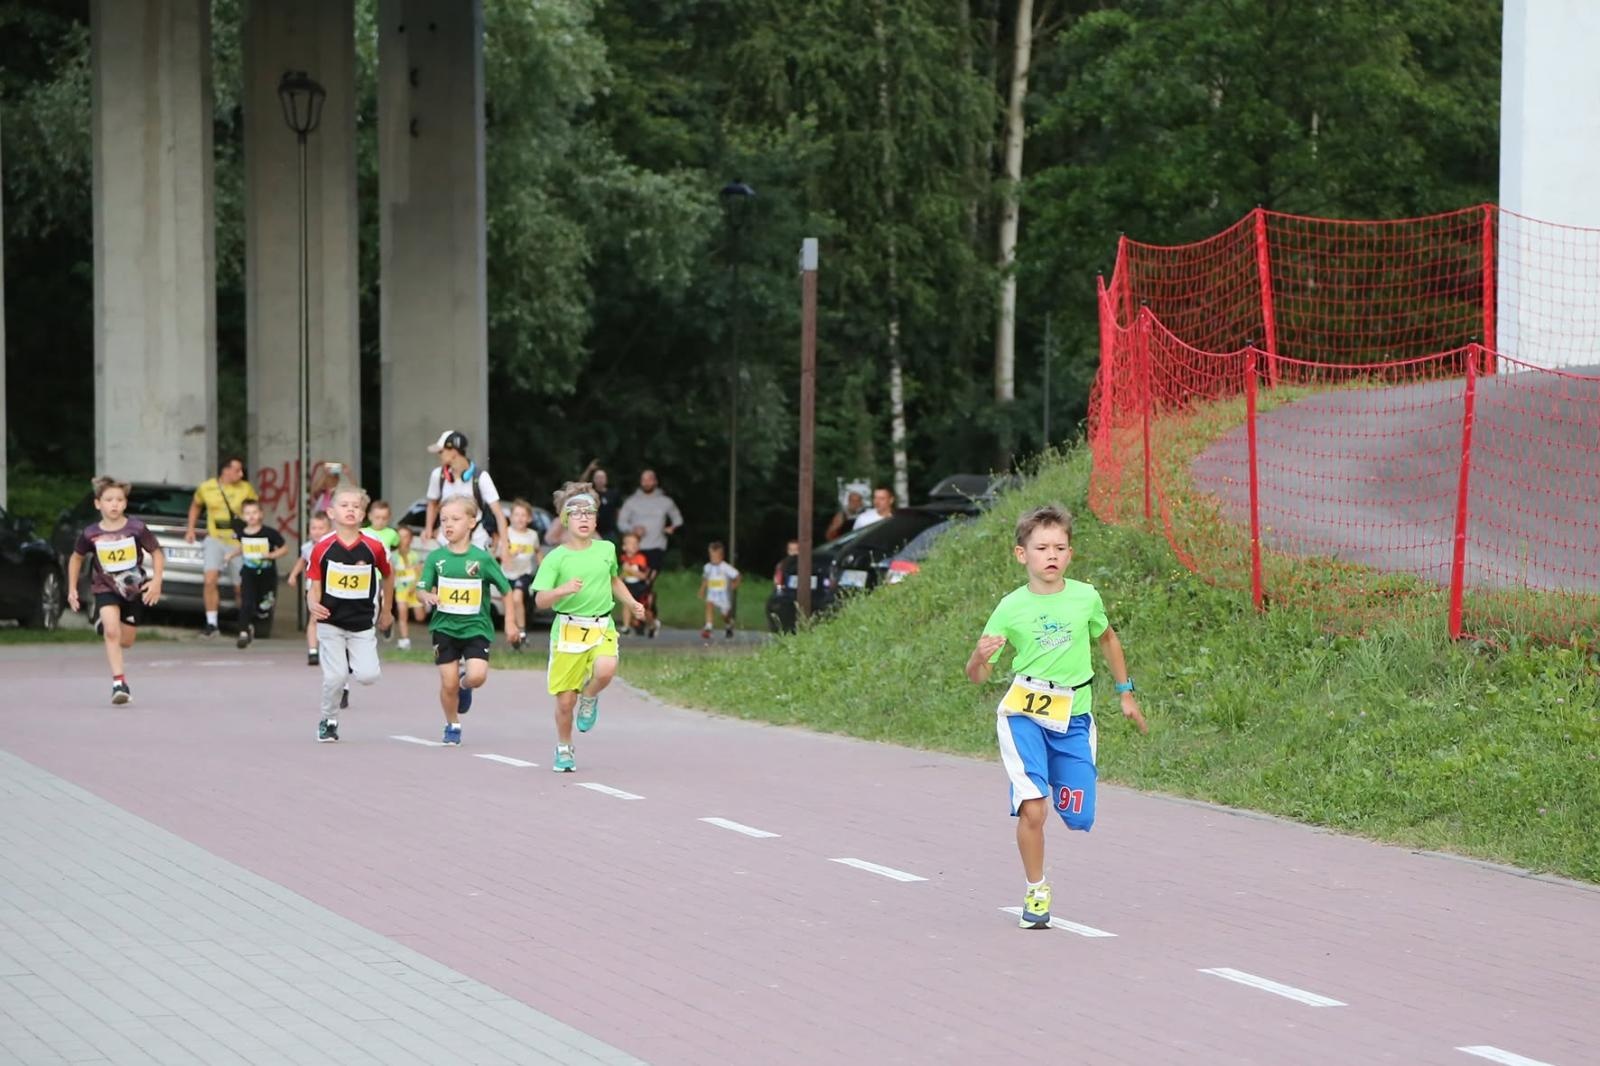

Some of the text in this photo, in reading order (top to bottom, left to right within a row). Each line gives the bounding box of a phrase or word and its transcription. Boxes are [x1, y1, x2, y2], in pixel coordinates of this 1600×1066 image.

[107, 549, 127, 562] 42
[338, 575, 359, 589] 43
[449, 589, 470, 603] 44
[579, 627, 590, 642] 7
[1022, 692, 1052, 716] 12
[1057, 787, 1085, 814] 91
